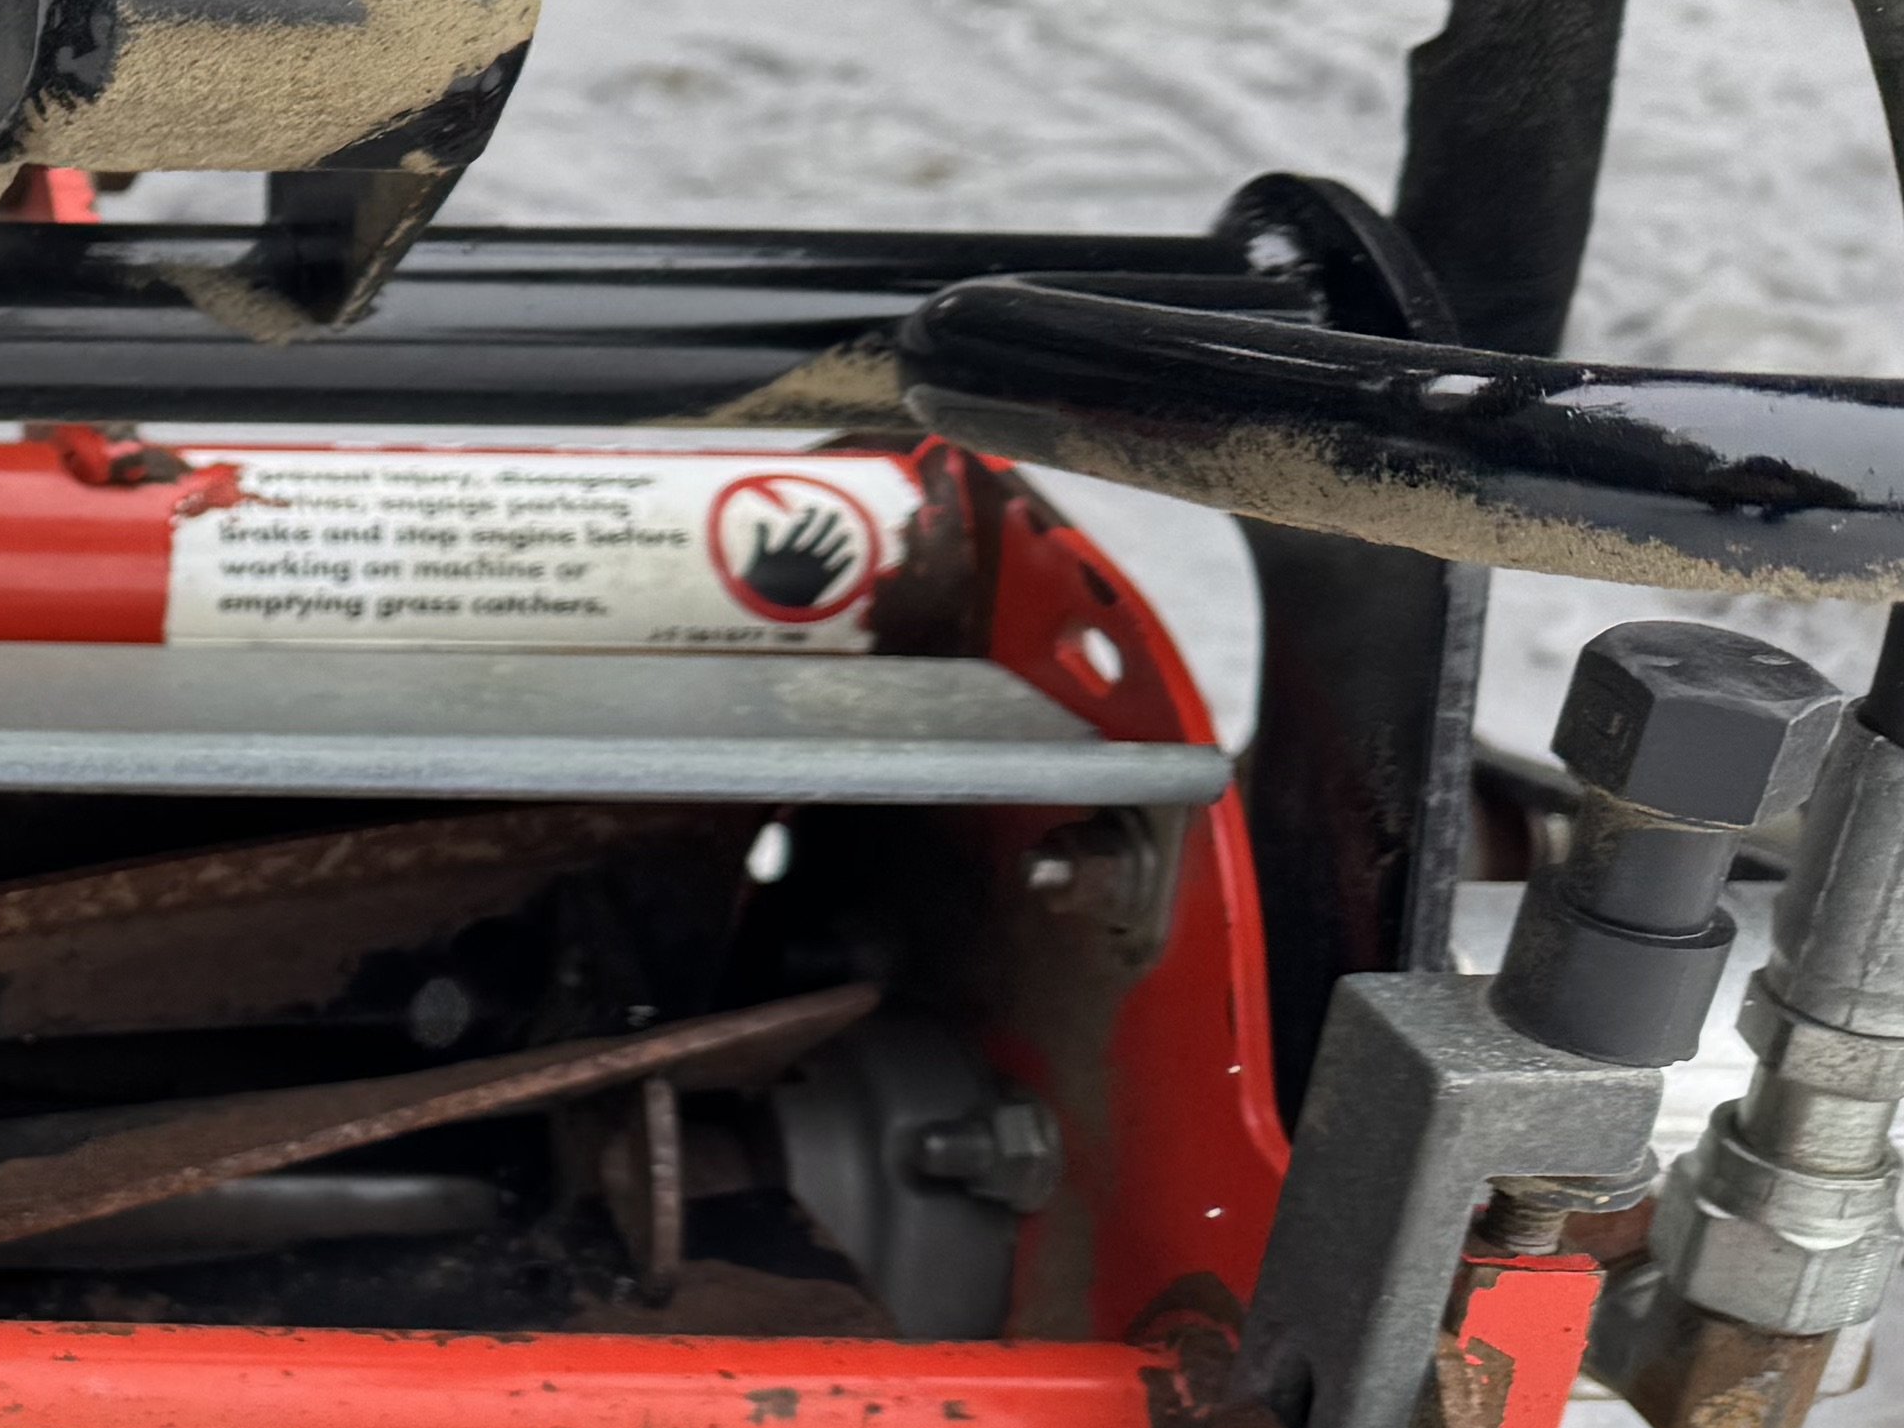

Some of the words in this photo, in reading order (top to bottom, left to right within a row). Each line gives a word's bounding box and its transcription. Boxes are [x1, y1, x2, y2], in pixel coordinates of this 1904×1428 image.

[471, 526, 576, 550] engine
[585, 522, 689, 548] before
[220, 551, 352, 583] working
[413, 554, 544, 580] machine
[219, 588, 365, 619] emptying
[376, 595, 462, 619] grass
[471, 590, 608, 616] catchers.
